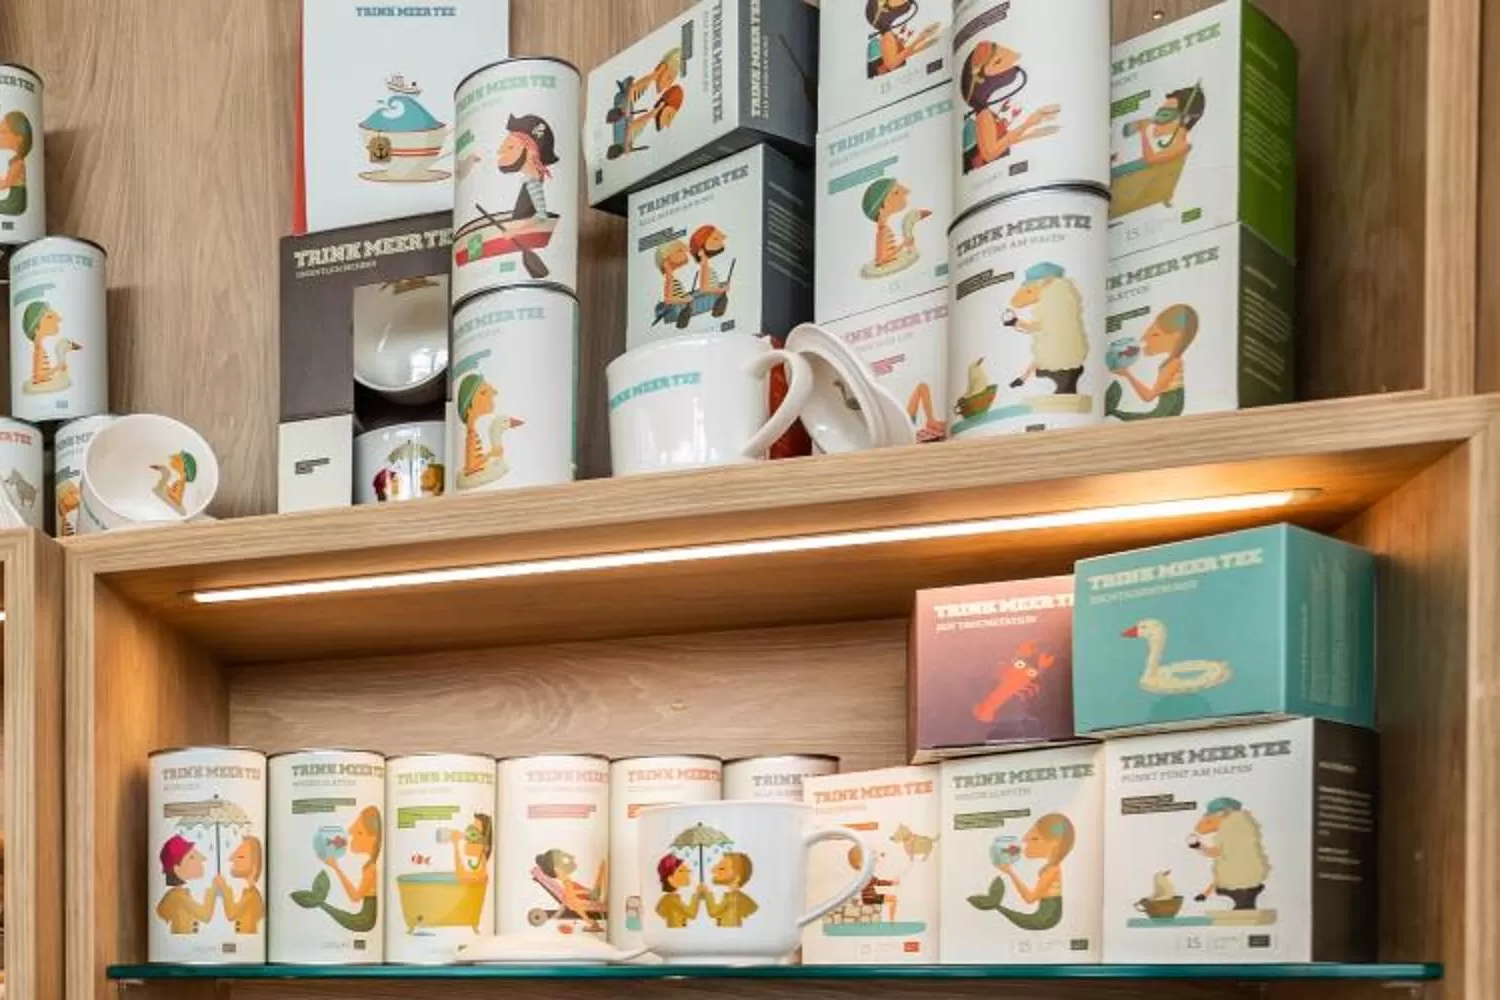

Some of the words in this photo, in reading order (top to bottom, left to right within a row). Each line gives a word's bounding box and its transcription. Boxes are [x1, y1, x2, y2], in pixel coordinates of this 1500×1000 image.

[356, 6, 395, 17] TRINK
[397, 6, 432, 17] MEER
[433, 6, 457, 17] TEE
[638, 193, 680, 216] TRINK
[682, 174, 721, 199] MEER
[722, 164, 750, 186] TEE
[294, 242, 362, 269] TRINK
[364, 232, 422, 257] MEER
[423, 228, 452, 249] TE
[956, 226, 1003, 257] TRINK
[1006, 215, 1061, 237] MEER
[1062, 215, 1093, 230] TEE
[1127, 258, 1180, 284] MEER
[1182, 246, 1220, 269] TEE
[292, 763, 337, 777] TRINK
[1120, 750, 1185, 771] TRINK
[1188, 744, 1247, 764] MEER
[1249, 740, 1293, 757] TEE
[952, 770, 1007, 789] TRINK
[1009, 766, 1058, 785] MEER
[1060, 763, 1094, 779] TEE
